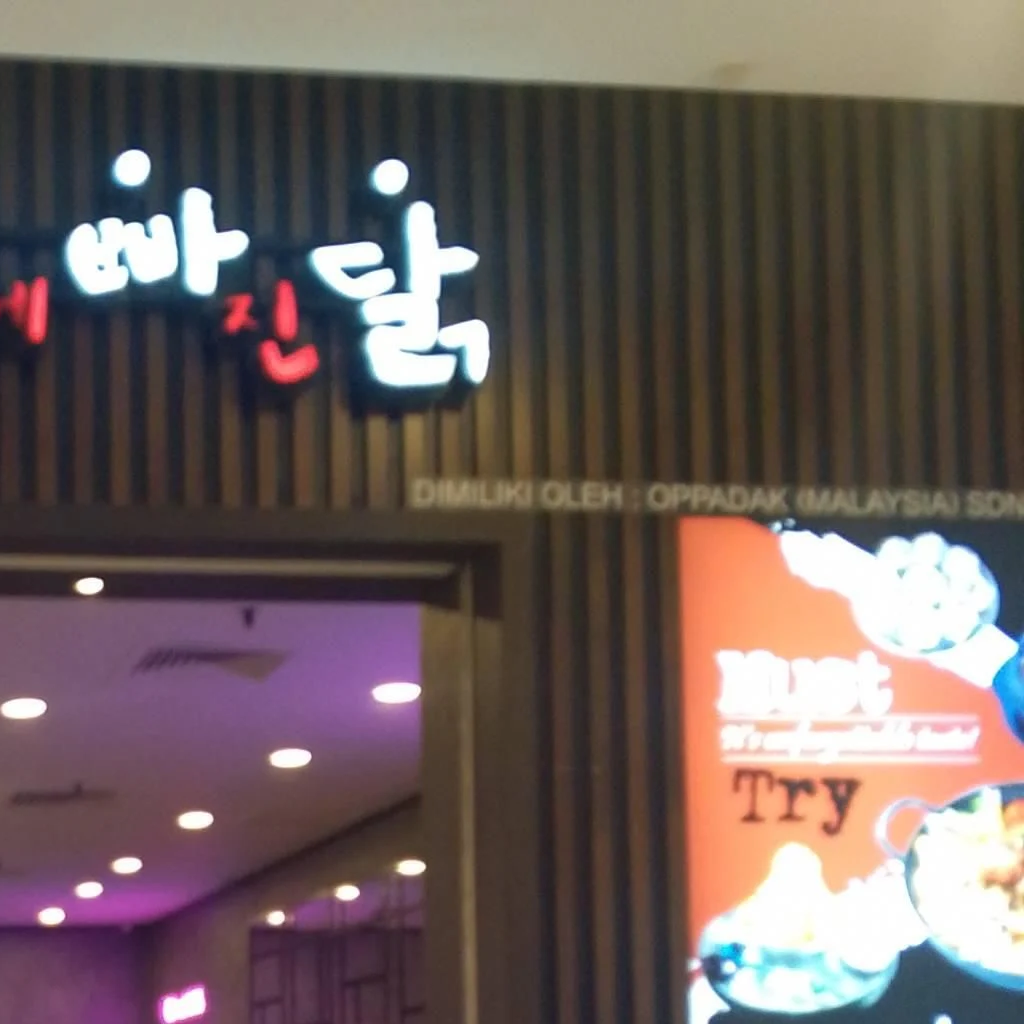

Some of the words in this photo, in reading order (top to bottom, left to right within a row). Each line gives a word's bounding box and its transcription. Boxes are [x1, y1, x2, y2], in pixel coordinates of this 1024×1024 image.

[412, 479, 533, 510] DIMILIKI
[541, 480, 624, 508] OLEH
[647, 482, 789, 513] OPPADAK
[732, 768, 861, 836] Try
